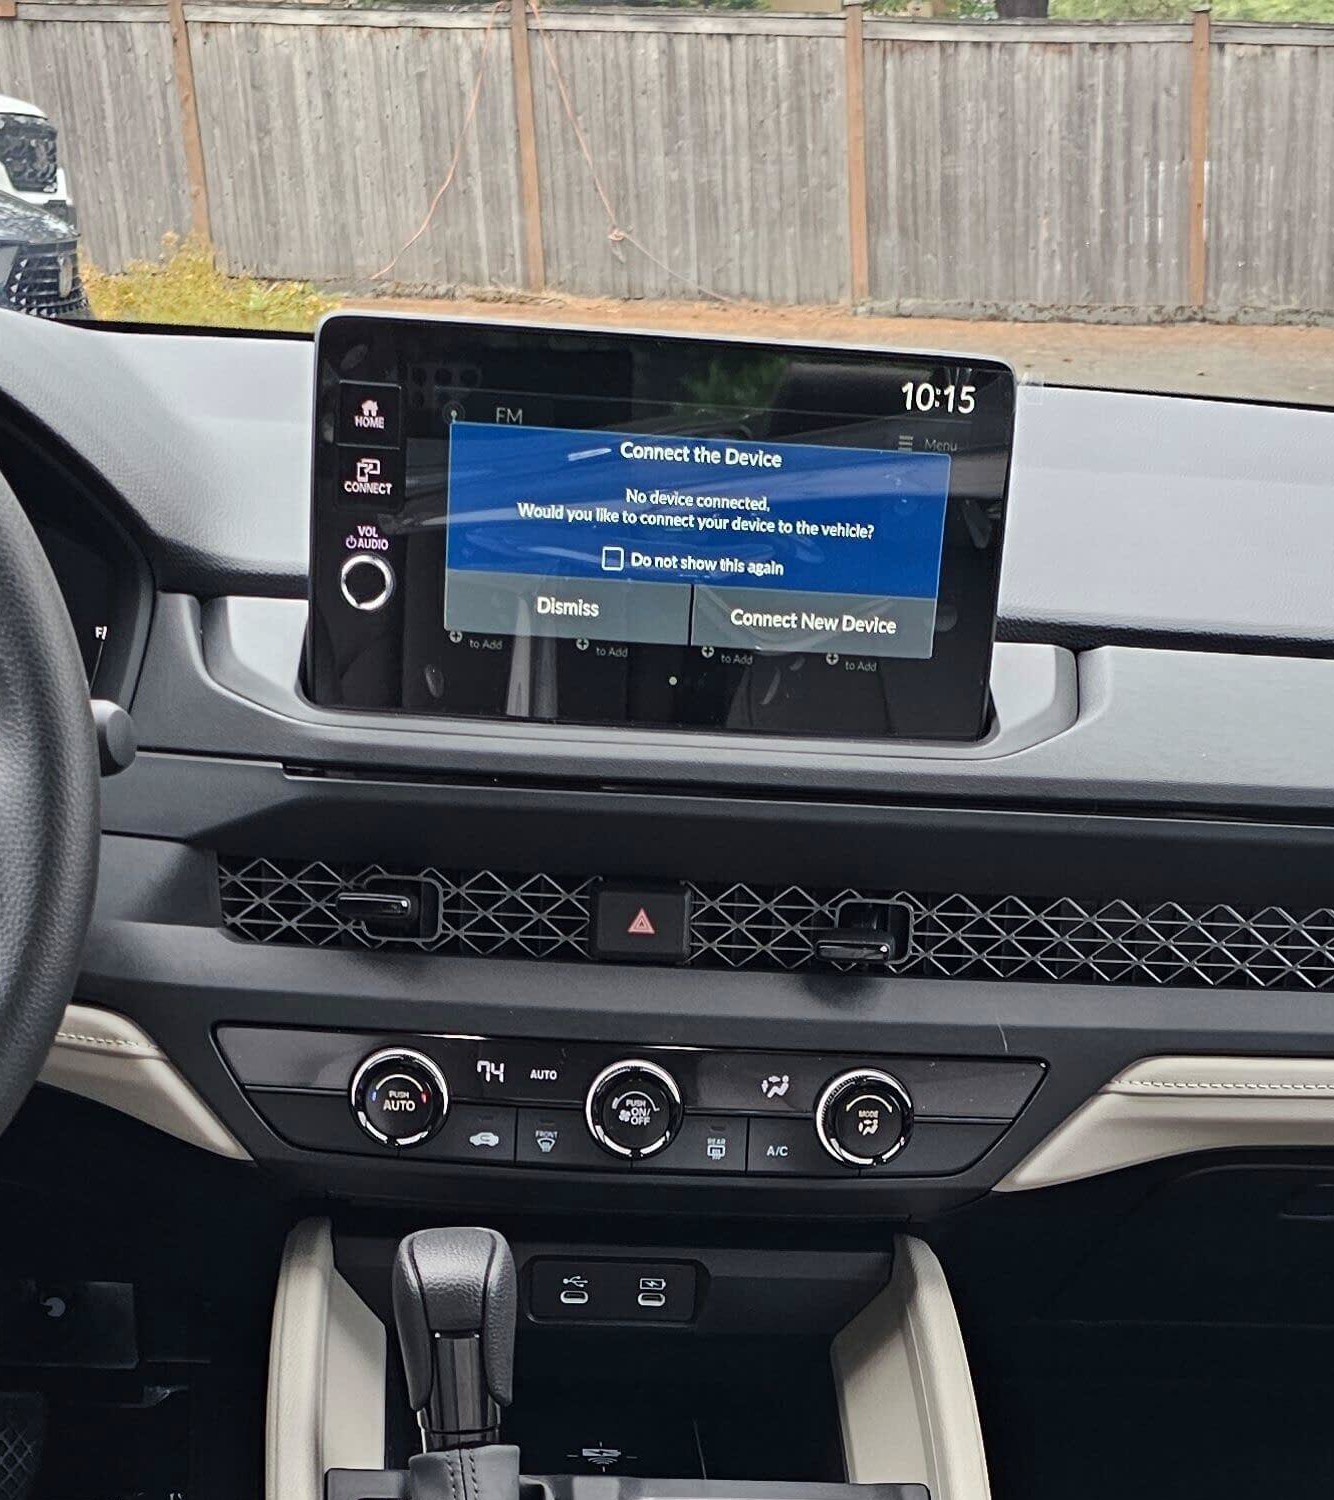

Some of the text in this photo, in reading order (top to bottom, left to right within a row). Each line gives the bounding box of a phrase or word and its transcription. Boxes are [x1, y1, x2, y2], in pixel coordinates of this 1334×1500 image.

[901, 382, 976, 414] 10:15
[496, 407, 523, 425] FM
[354, 416, 384, 430] HOME
[924, 439, 958, 452] Menu
[620, 441, 783, 468] Connect the Device
[344, 481, 392, 495] CONNECT
[626, 488, 647, 503] No
[650, 490, 694, 507] device
[517, 502, 874, 539] Would you like to connect your device to the vehicle?
[357, 526, 378, 538] VOL
[357, 538, 389, 550] AUDIO
[631, 552, 784, 576] Do not show this again
[537, 596, 599, 617] Dismiss
[730, 608, 897, 635] Connect New Device
[469, 639, 503, 650] to Add
[596, 647, 628, 658] to Add
[721, 654, 753, 665] to Add
[845, 662, 877, 672] to Add
[476, 1060, 505, 1083] 74
[530, 1068, 557, 1081] AUTO
[388, 1090, 410, 1100] PUSH
[383, 1099, 416, 1112] AUTO
[625, 1098, 646, 1108] PUSH
[630, 1107, 651, 1118] ON/
[858, 1110, 879, 1118] MODE
[630, 1115, 651, 1126] OFF
[535, 1130, 558, 1139] FRONT
[707, 1138, 726, 1146] REAR
[766, 1145, 788, 1157] A/C
